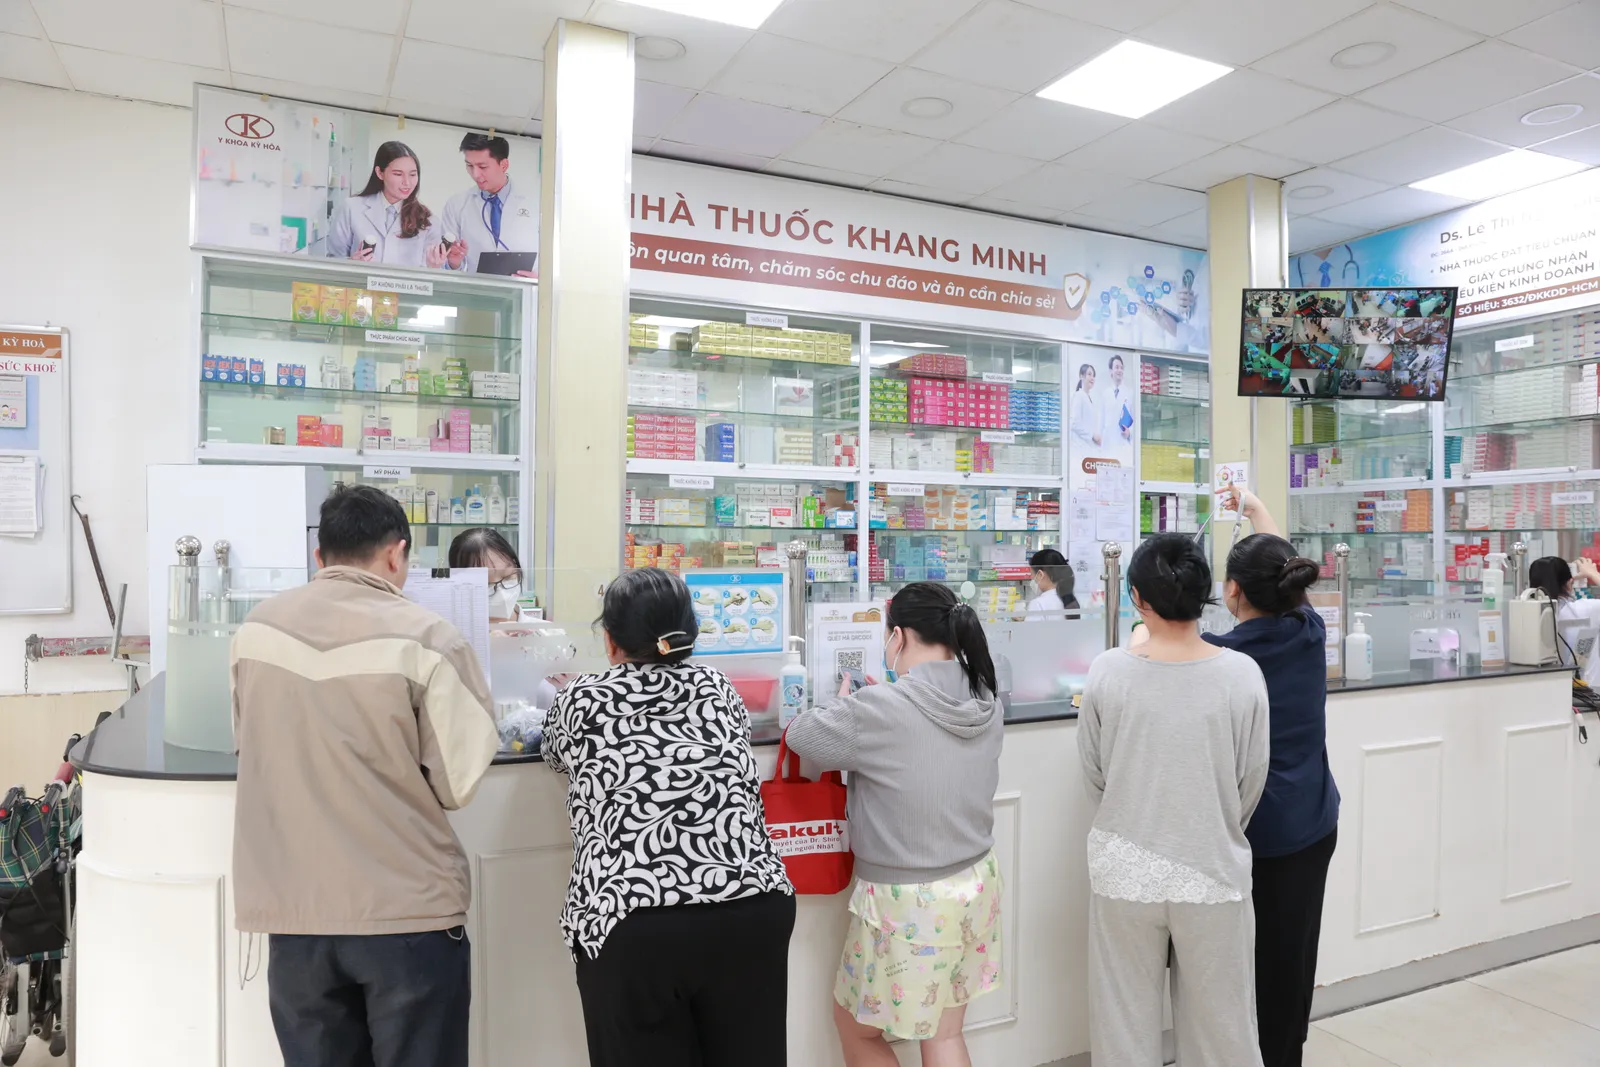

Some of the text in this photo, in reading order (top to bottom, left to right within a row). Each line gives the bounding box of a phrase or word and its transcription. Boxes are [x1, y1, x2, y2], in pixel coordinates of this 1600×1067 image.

[225, 138, 248, 147] KHOA
[708, 208, 834, 245] THUỐC
[848, 224, 960, 263] KHANG
[972, 243, 1046, 276] MINH
[1440, 231, 1463, 244] Ds.
[655, 248, 705, 265] quan
[712, 253, 754, 273] tâm,
[759, 260, 811, 278] chăm
[816, 266, 846, 282] sóc
[850, 270, 881, 287] chu
[886, 275, 918, 291] đáo
[922, 281, 941, 294] và
[945, 282, 965, 297] ân
[969, 285, 997, 301] cần
[1001, 291, 1032, 306] chia
[1035, 294, 1056, 309] sẻ!
[1509, 273, 1540, 288] KINH
[1544, 262, 1595, 281] DOANH
[1458, 304, 1472, 315] SỐ
[1474, 301, 1500, 313] HIỆU:
[2, 336, 45, 348] KỲ HOÀ
[24, 361, 57, 373] KHOẺ
[597, 584, 604, 597] 4
[766, 822, 843, 840] akult
